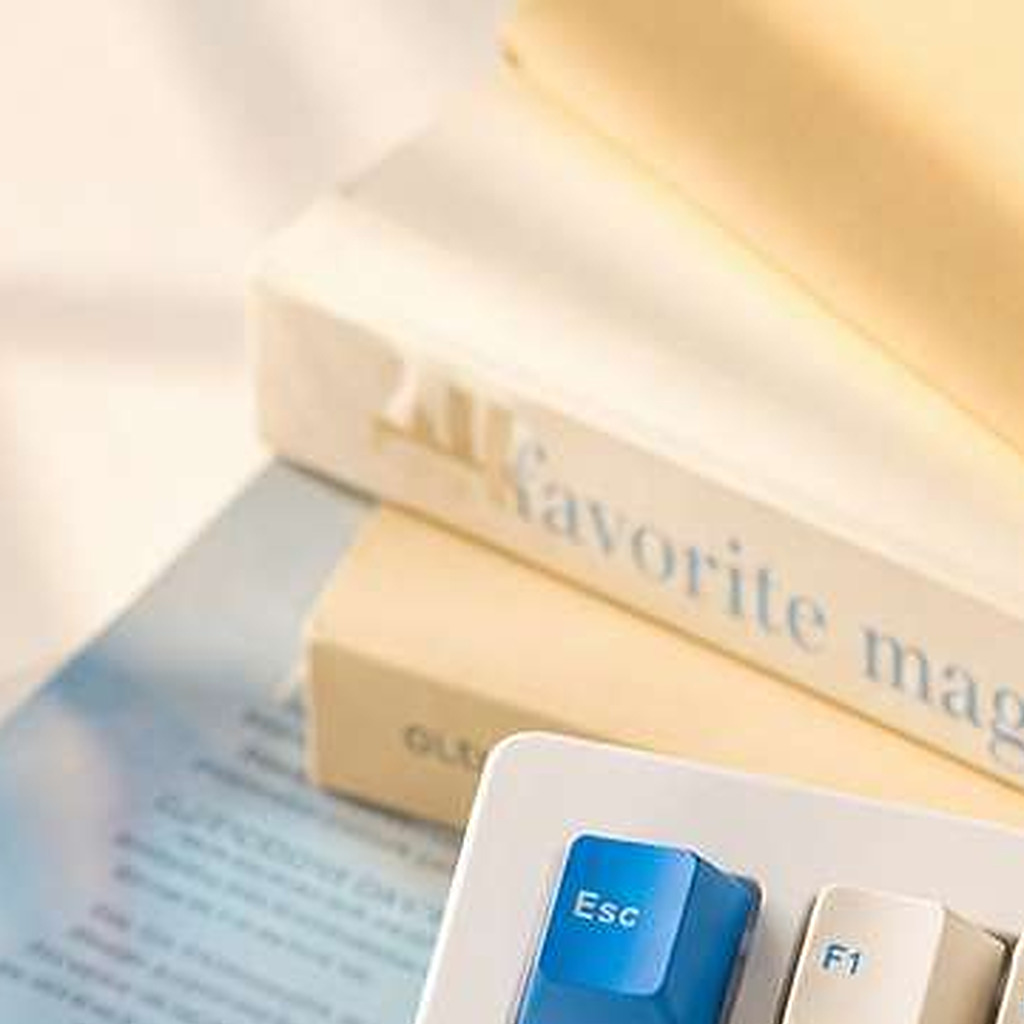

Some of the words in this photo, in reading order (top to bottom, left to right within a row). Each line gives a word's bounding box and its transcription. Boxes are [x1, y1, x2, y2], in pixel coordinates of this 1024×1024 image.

[515, 441, 828, 654] favorite
[572, 889, 642, 929] Esc
[822, 943, 861, 975] F1
